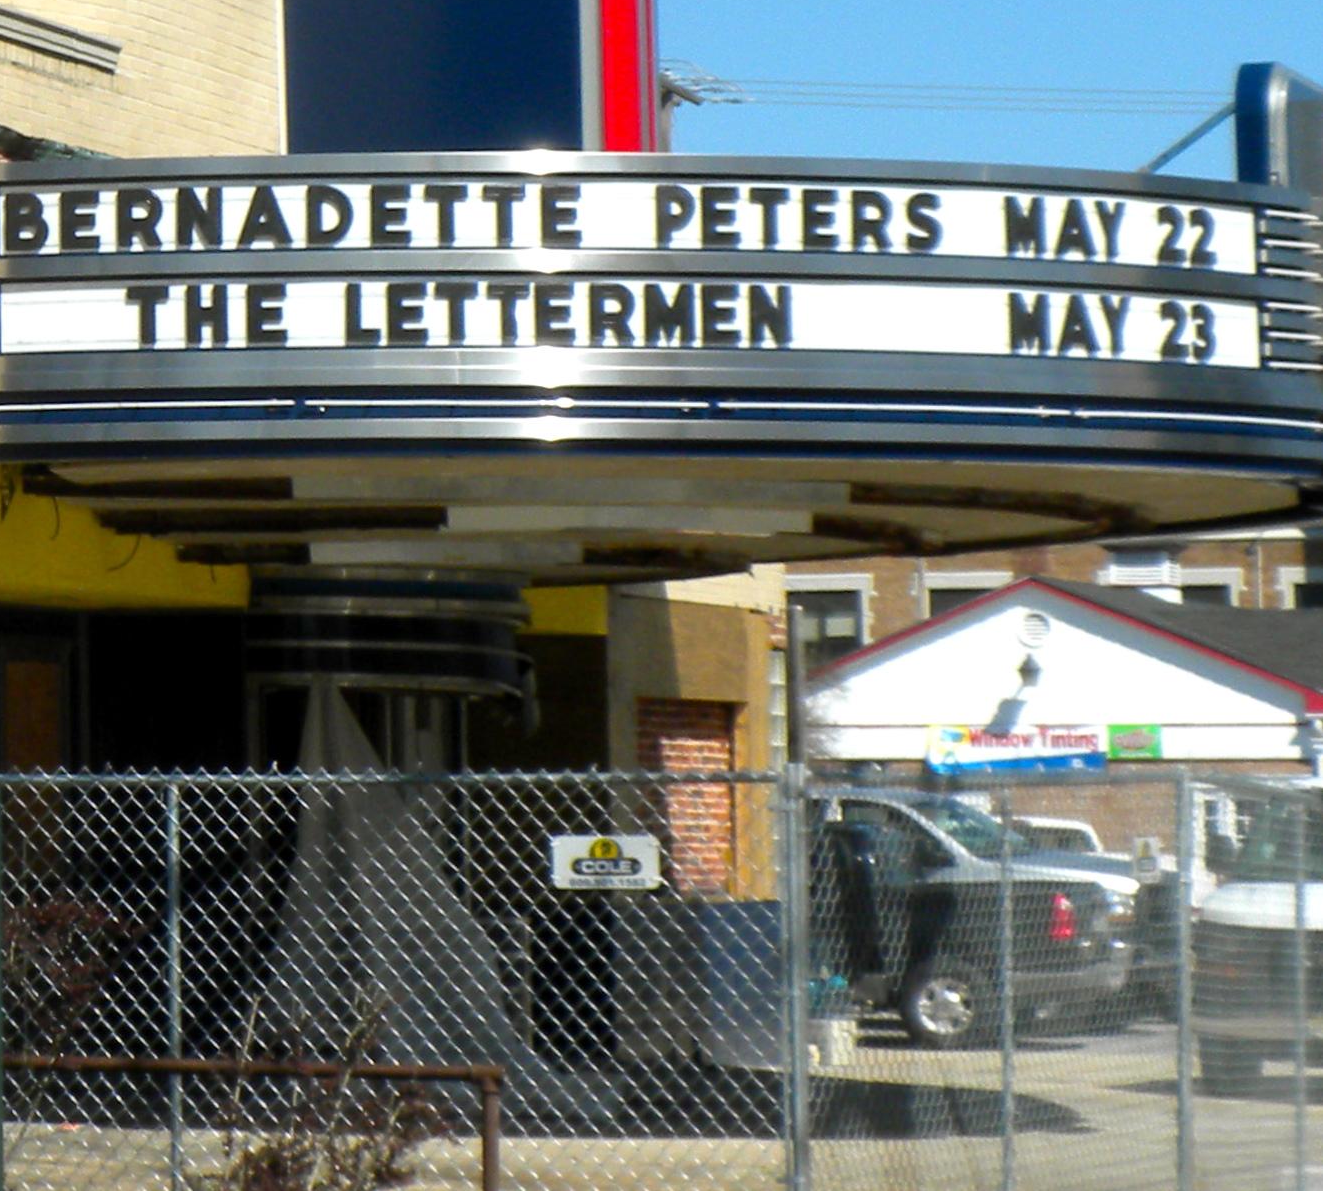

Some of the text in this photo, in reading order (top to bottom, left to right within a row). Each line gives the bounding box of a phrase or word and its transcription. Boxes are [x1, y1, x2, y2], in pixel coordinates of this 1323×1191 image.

[1, 183, 1219, 267] BERNADETTE PETERS MAY 22
[125, 282, 1219, 362] THE LETTERMEN MAY 23
[1036, 726, 1099, 752] Tinting
[581, 860, 633, 874] COLE
